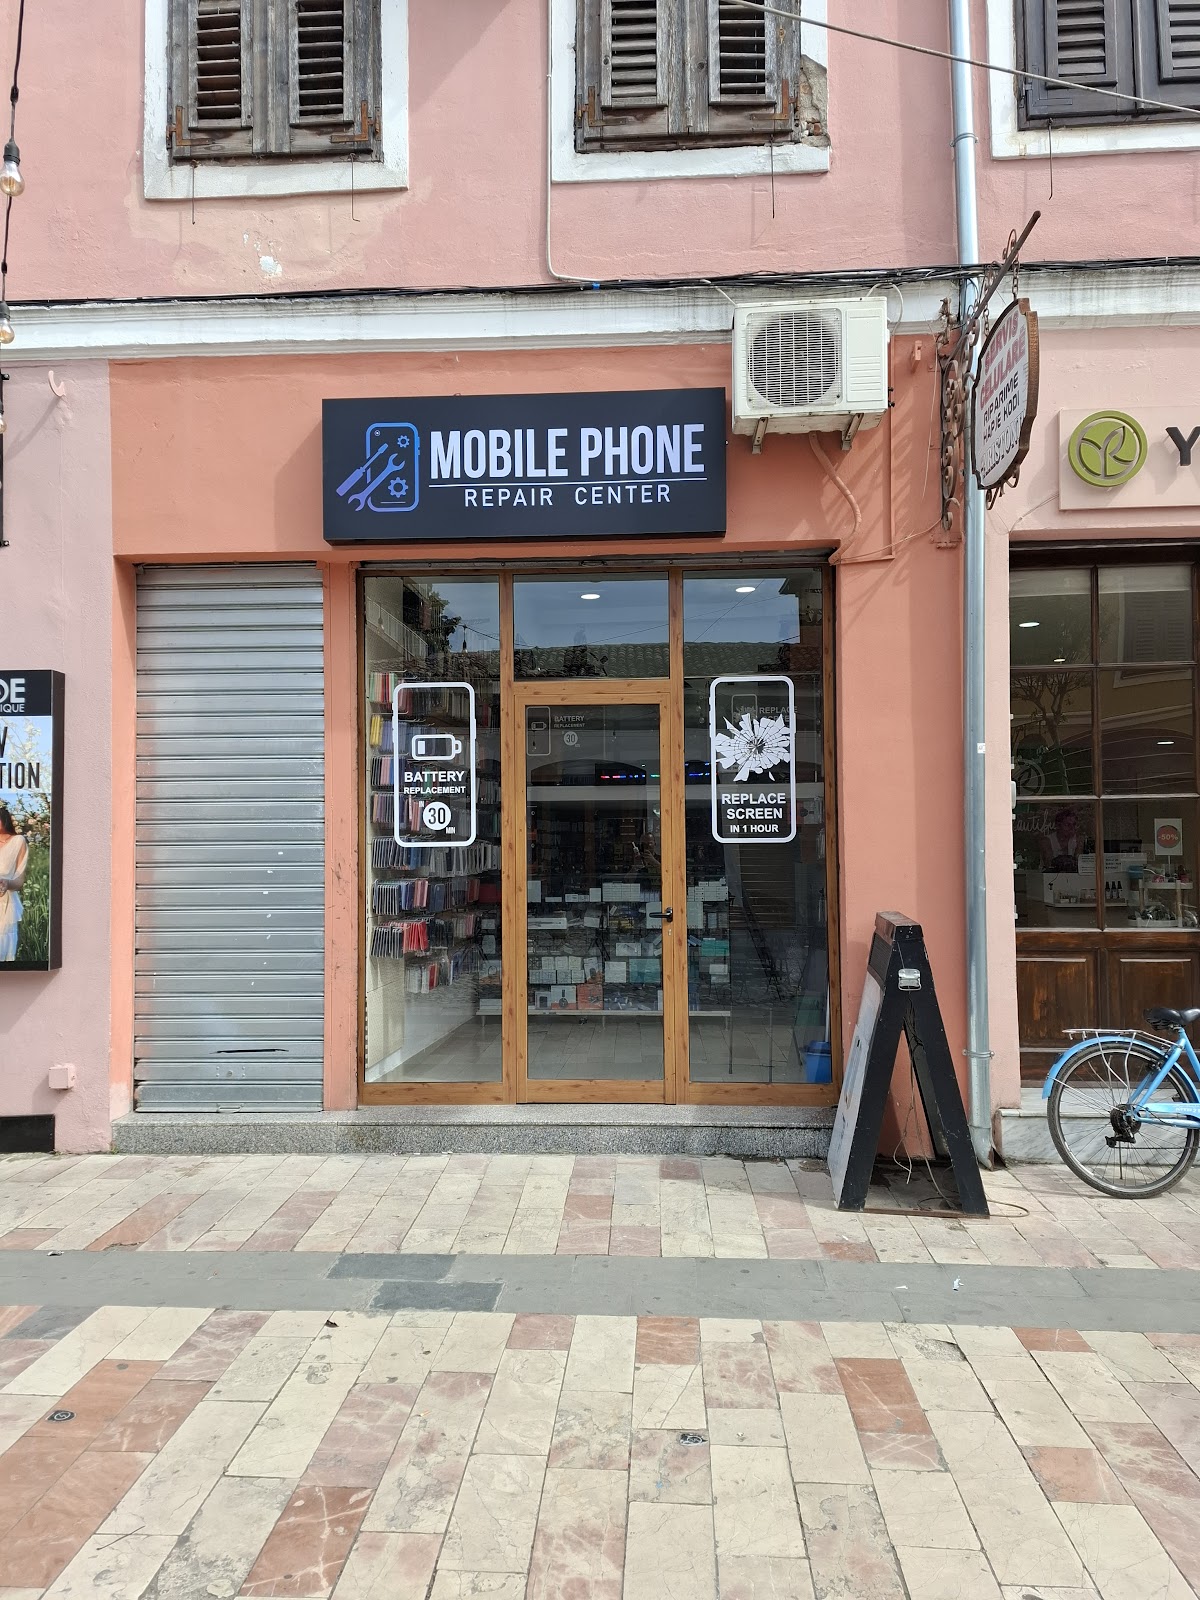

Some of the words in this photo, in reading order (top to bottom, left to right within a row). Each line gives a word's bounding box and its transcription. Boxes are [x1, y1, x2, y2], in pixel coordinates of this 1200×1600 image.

[984, 310, 1019, 375] SERVIS
[983, 371, 1019, 427] RIPARIME
[983, 411, 1001, 446] HAPJE
[1003, 392, 1020, 424] KODI
[430, 428, 569, 479] MOBILE
[580, 423, 705, 477] PHONE
[1165, 426, 1200, 467] Y
[465, 487, 553, 507] REPAIR
[575, 484, 671, 505] CENTER
[566, 733, 576, 743] 30
[0, 762, 40, 789] TION
[404, 771, 465, 782] BATTERY
[404, 786, 466, 794] REPLACEMENT
[721, 793, 786, 804] REPLACE
[428, 807, 446, 825] 30
[726, 808, 783, 820] SCREEN
[730, 824, 740, 833] IN
[742, 824, 747, 833] 1
[750, 824, 779, 833] HOUR
[1158, 833, 1179, 841] -50%
